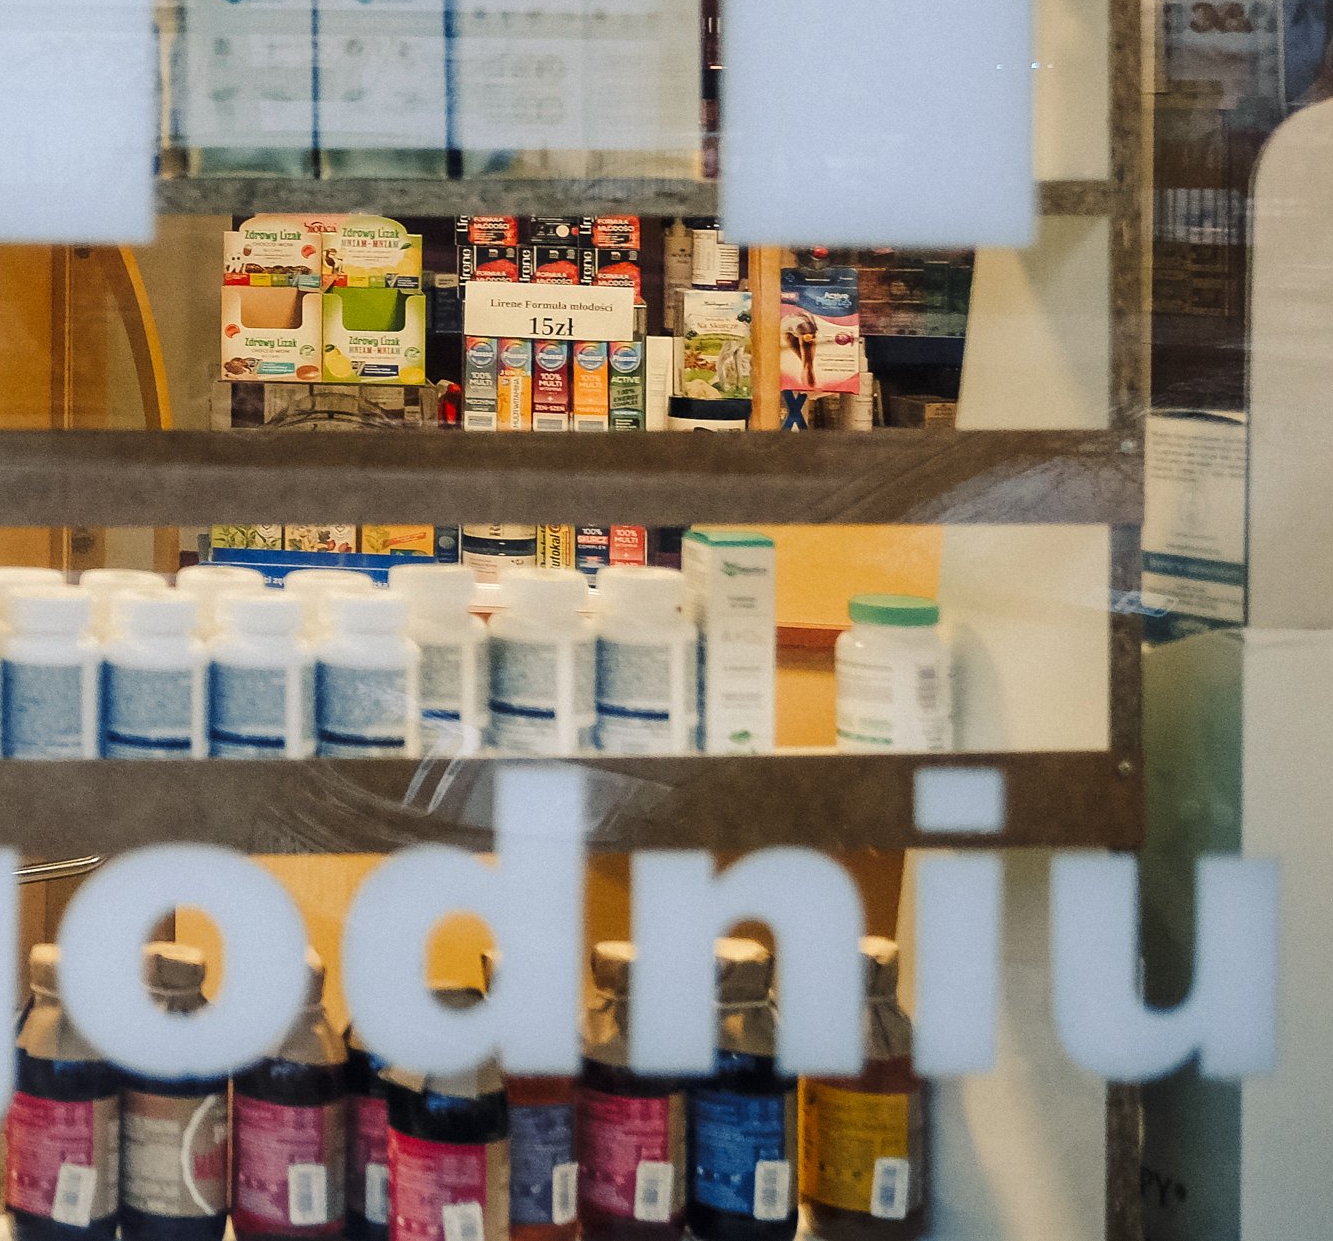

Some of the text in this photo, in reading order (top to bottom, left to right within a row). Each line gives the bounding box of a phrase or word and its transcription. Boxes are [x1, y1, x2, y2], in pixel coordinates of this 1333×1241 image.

[245, 229, 301, 241] Zdrowy Lizak
[342, 228, 399, 239] Zdrowy Lizak
[490, 299, 613, 312] Lirene Formuła młodości
[529, 318, 574, 336] 15zł
[245, 337, 297, 348] Zdrowy Lizak
[349, 336, 400, 346] Zdrowy Lizak
[551, 535, 561, 569] utokal
